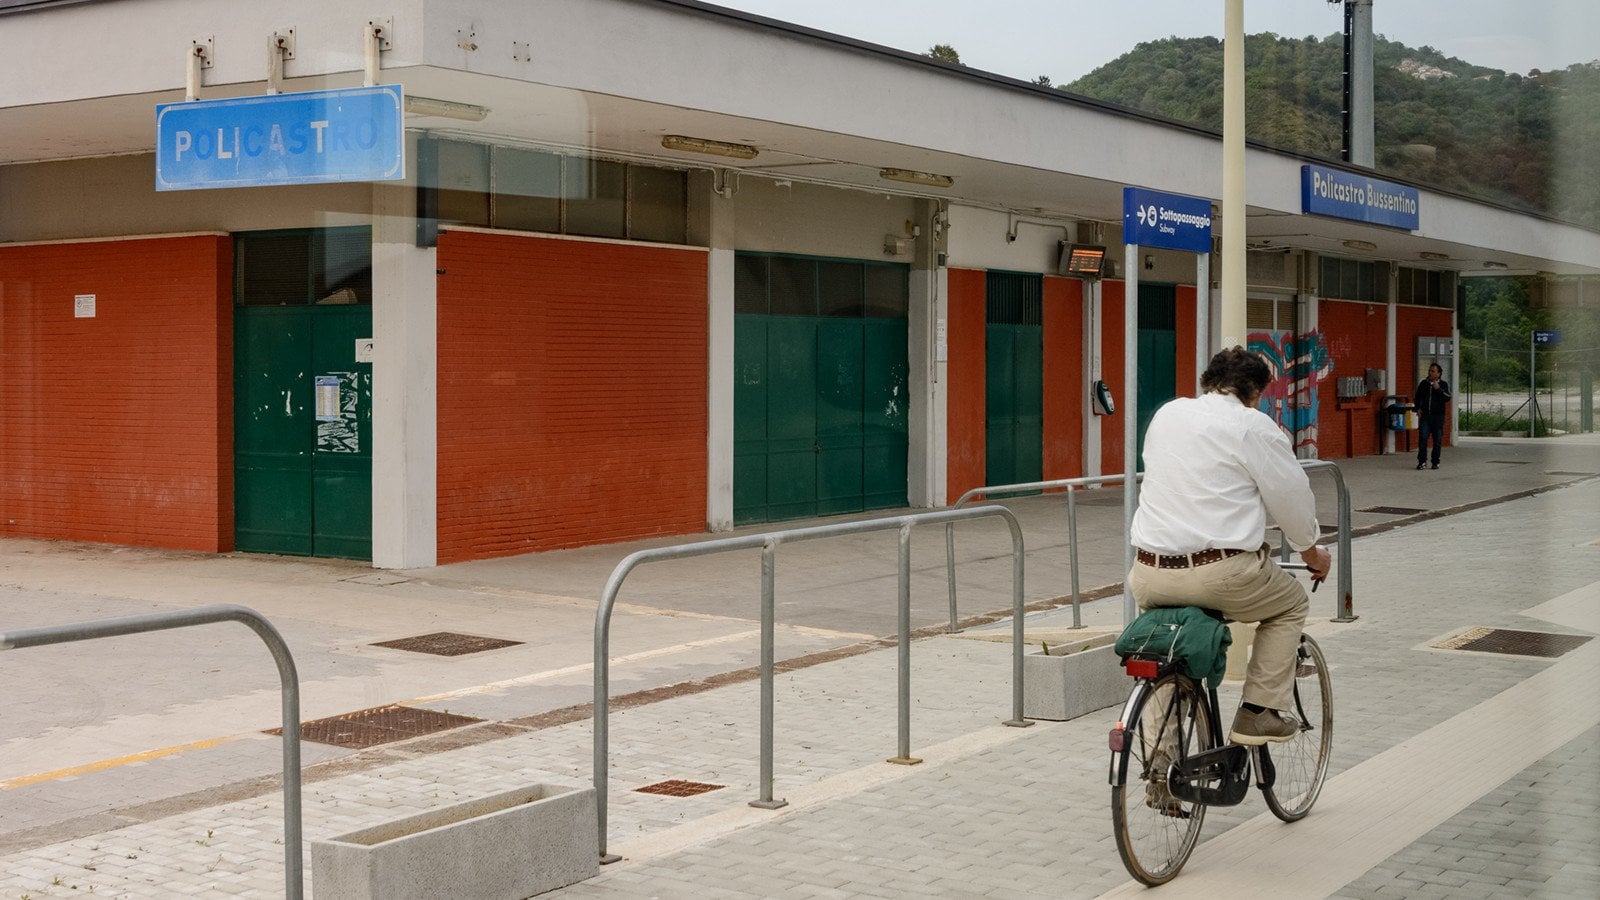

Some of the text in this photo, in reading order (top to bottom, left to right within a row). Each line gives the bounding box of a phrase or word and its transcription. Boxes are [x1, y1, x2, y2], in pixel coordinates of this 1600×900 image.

[175, 116, 378, 162] POLICASTRO
[1313, 171, 1416, 215] Policastro Bussentino
[1159, 207, 1211, 228] Sottopassaggio
[1159, 223, 1176, 235] Subway
